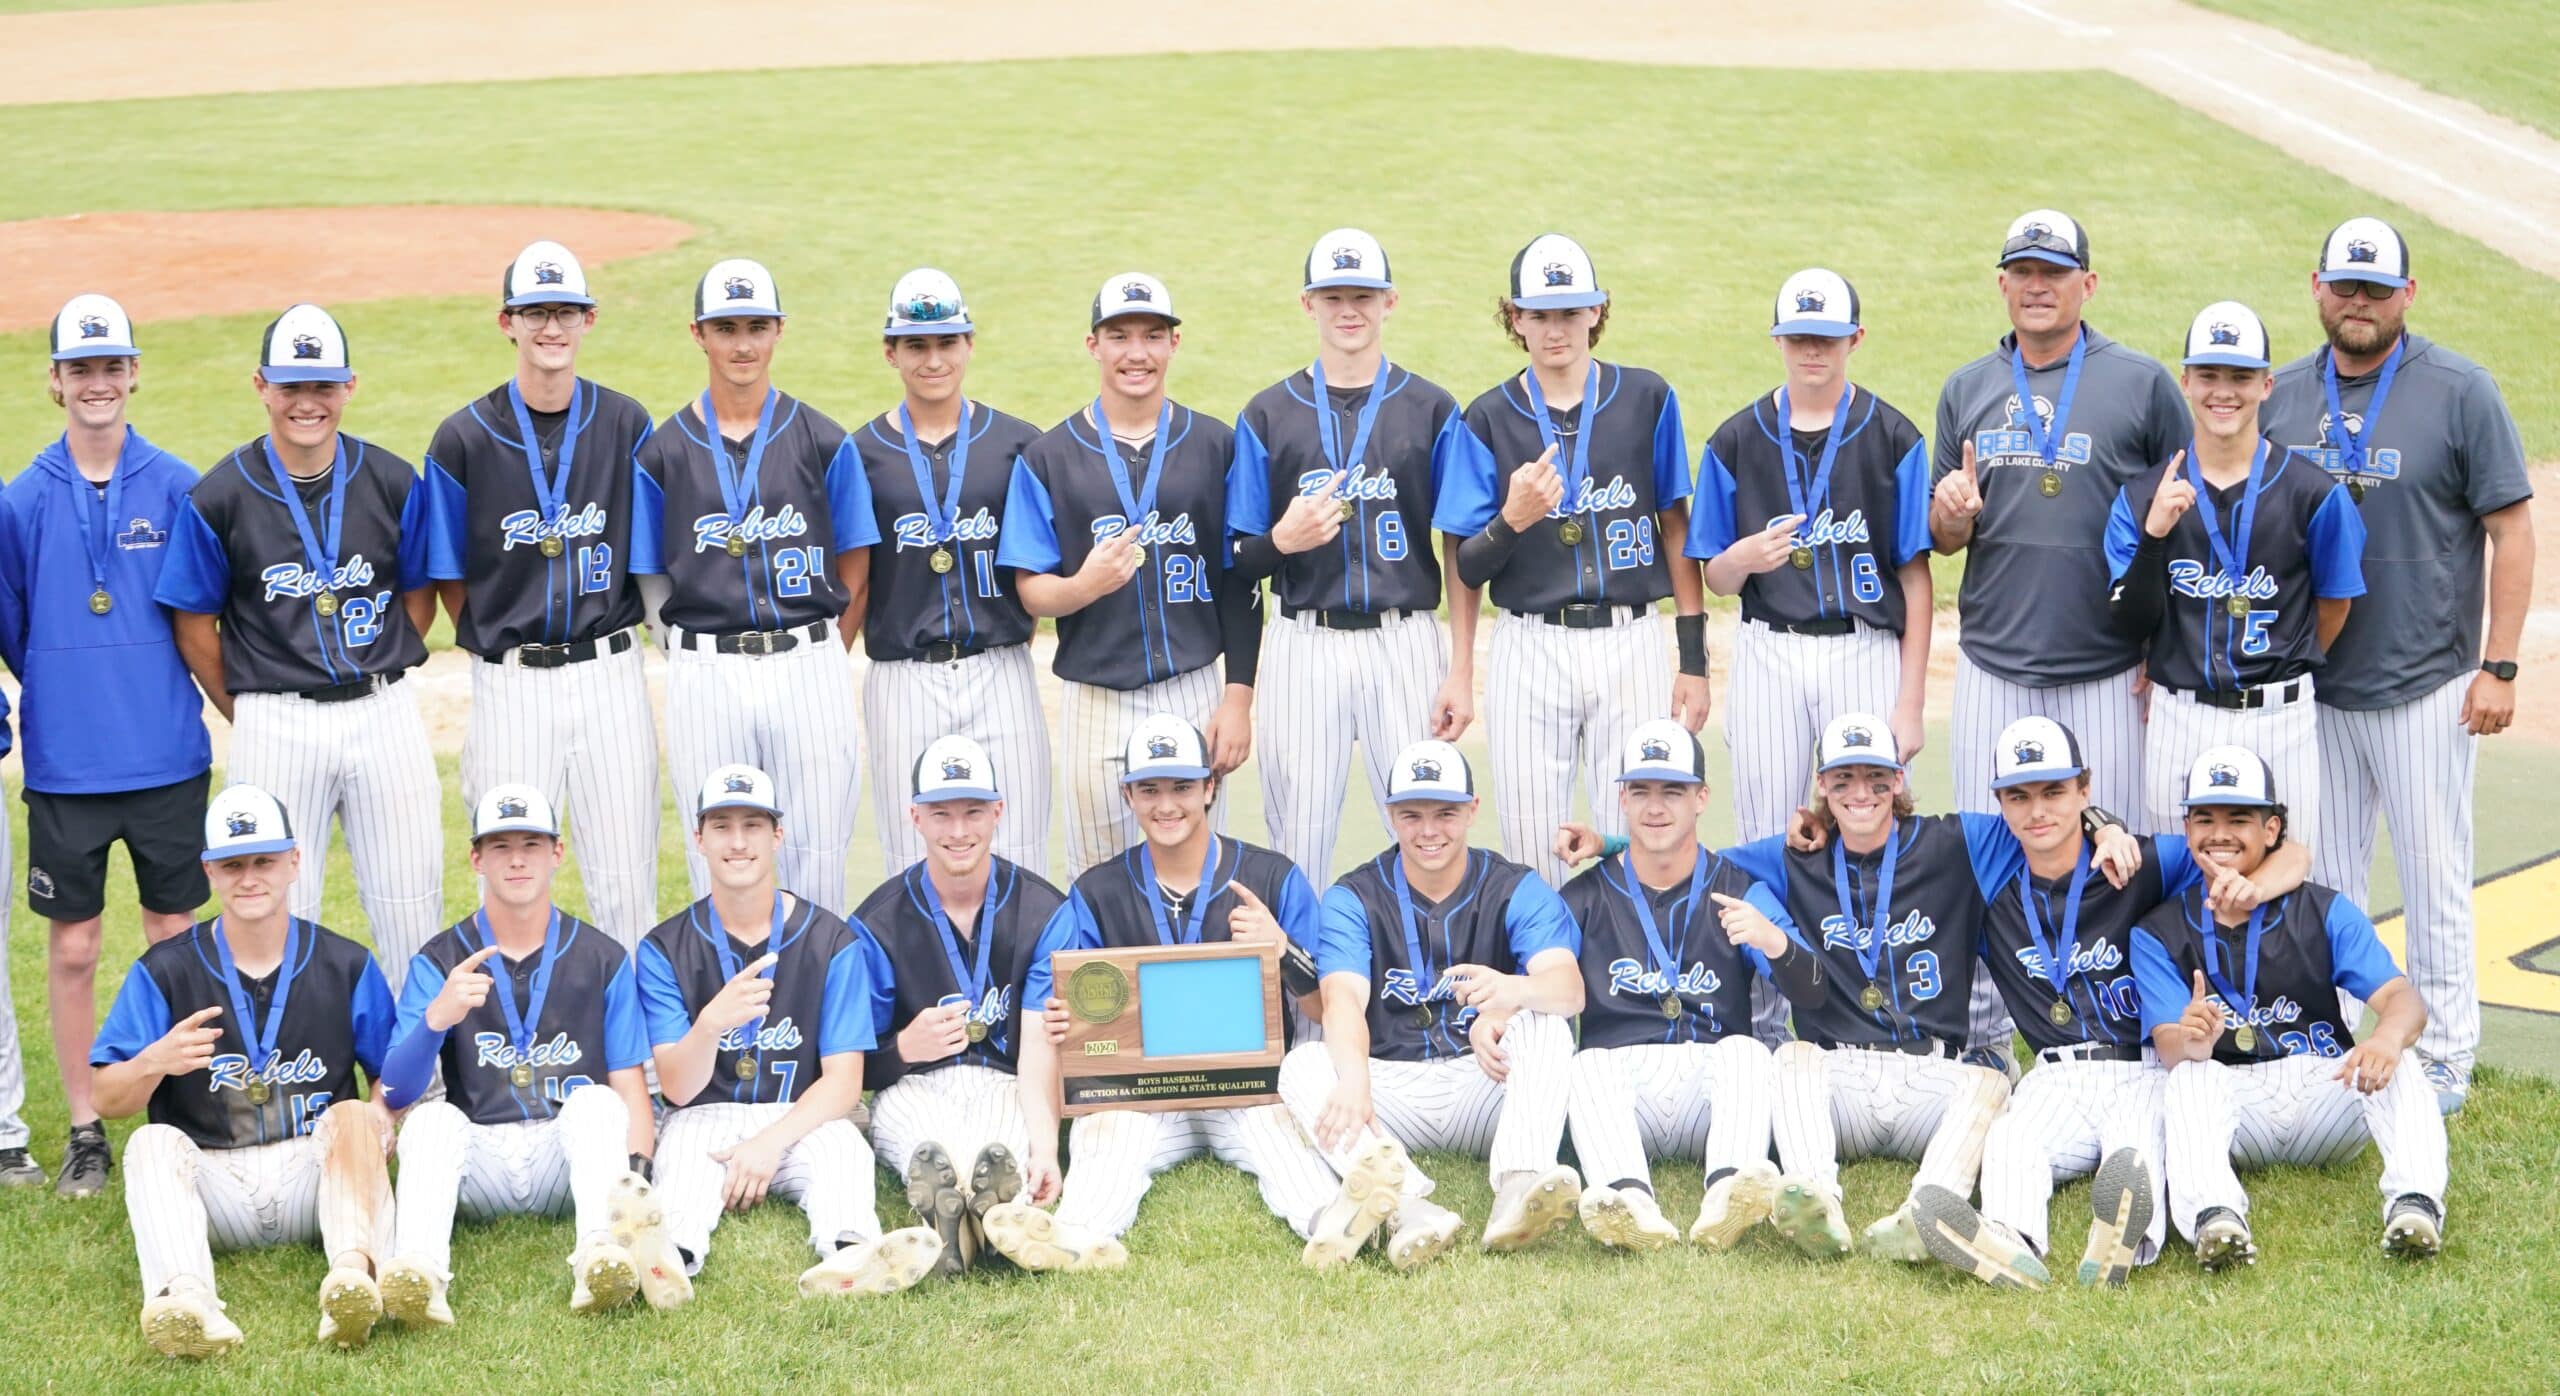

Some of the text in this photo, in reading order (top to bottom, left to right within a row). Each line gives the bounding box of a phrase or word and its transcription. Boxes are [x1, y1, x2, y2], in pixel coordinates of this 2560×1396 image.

[1976, 430, 2092, 465] REBS
[2006, 457, 2031, 467] LAKE
[2032, 458, 2071, 472] CONTY
[2288, 445, 2401, 480] EBLS
[1298, 464, 1397, 500] Rbels
[1545, 475, 1637, 519] bels
[501, 502, 606, 551] Rebels
[1091, 510, 1196, 546] Rbels
[1376, 510, 1408, 561] 8
[1606, 515, 1654, 571] 29
[578, 542, 612, 597] 12
[1851, 553, 1884, 603] 6
[2241, 609, 2279, 656] 5
[1821, 909, 1936, 951] Reels
[1906, 949, 1943, 1001] 3
[2015, 936, 2123, 979] Rbels
[2095, 975, 2141, 1021] 10
[2278, 1021, 2344, 1057] 26
[208, 1048, 328, 1092] Rebels
[771, 1060, 798, 1104] 7
[1079, 1088, 1118, 1098] SECTION
[1131, 1086, 1179, 1095] CHAMPION
[1180, 1084, 1188, 1093] &
[1189, 1083, 1217, 1092] STATE
[1218, 1080, 1266, 1091] QUALIFIER
[1137, 1075, 1208, 1086] BOYS BASEBALL
